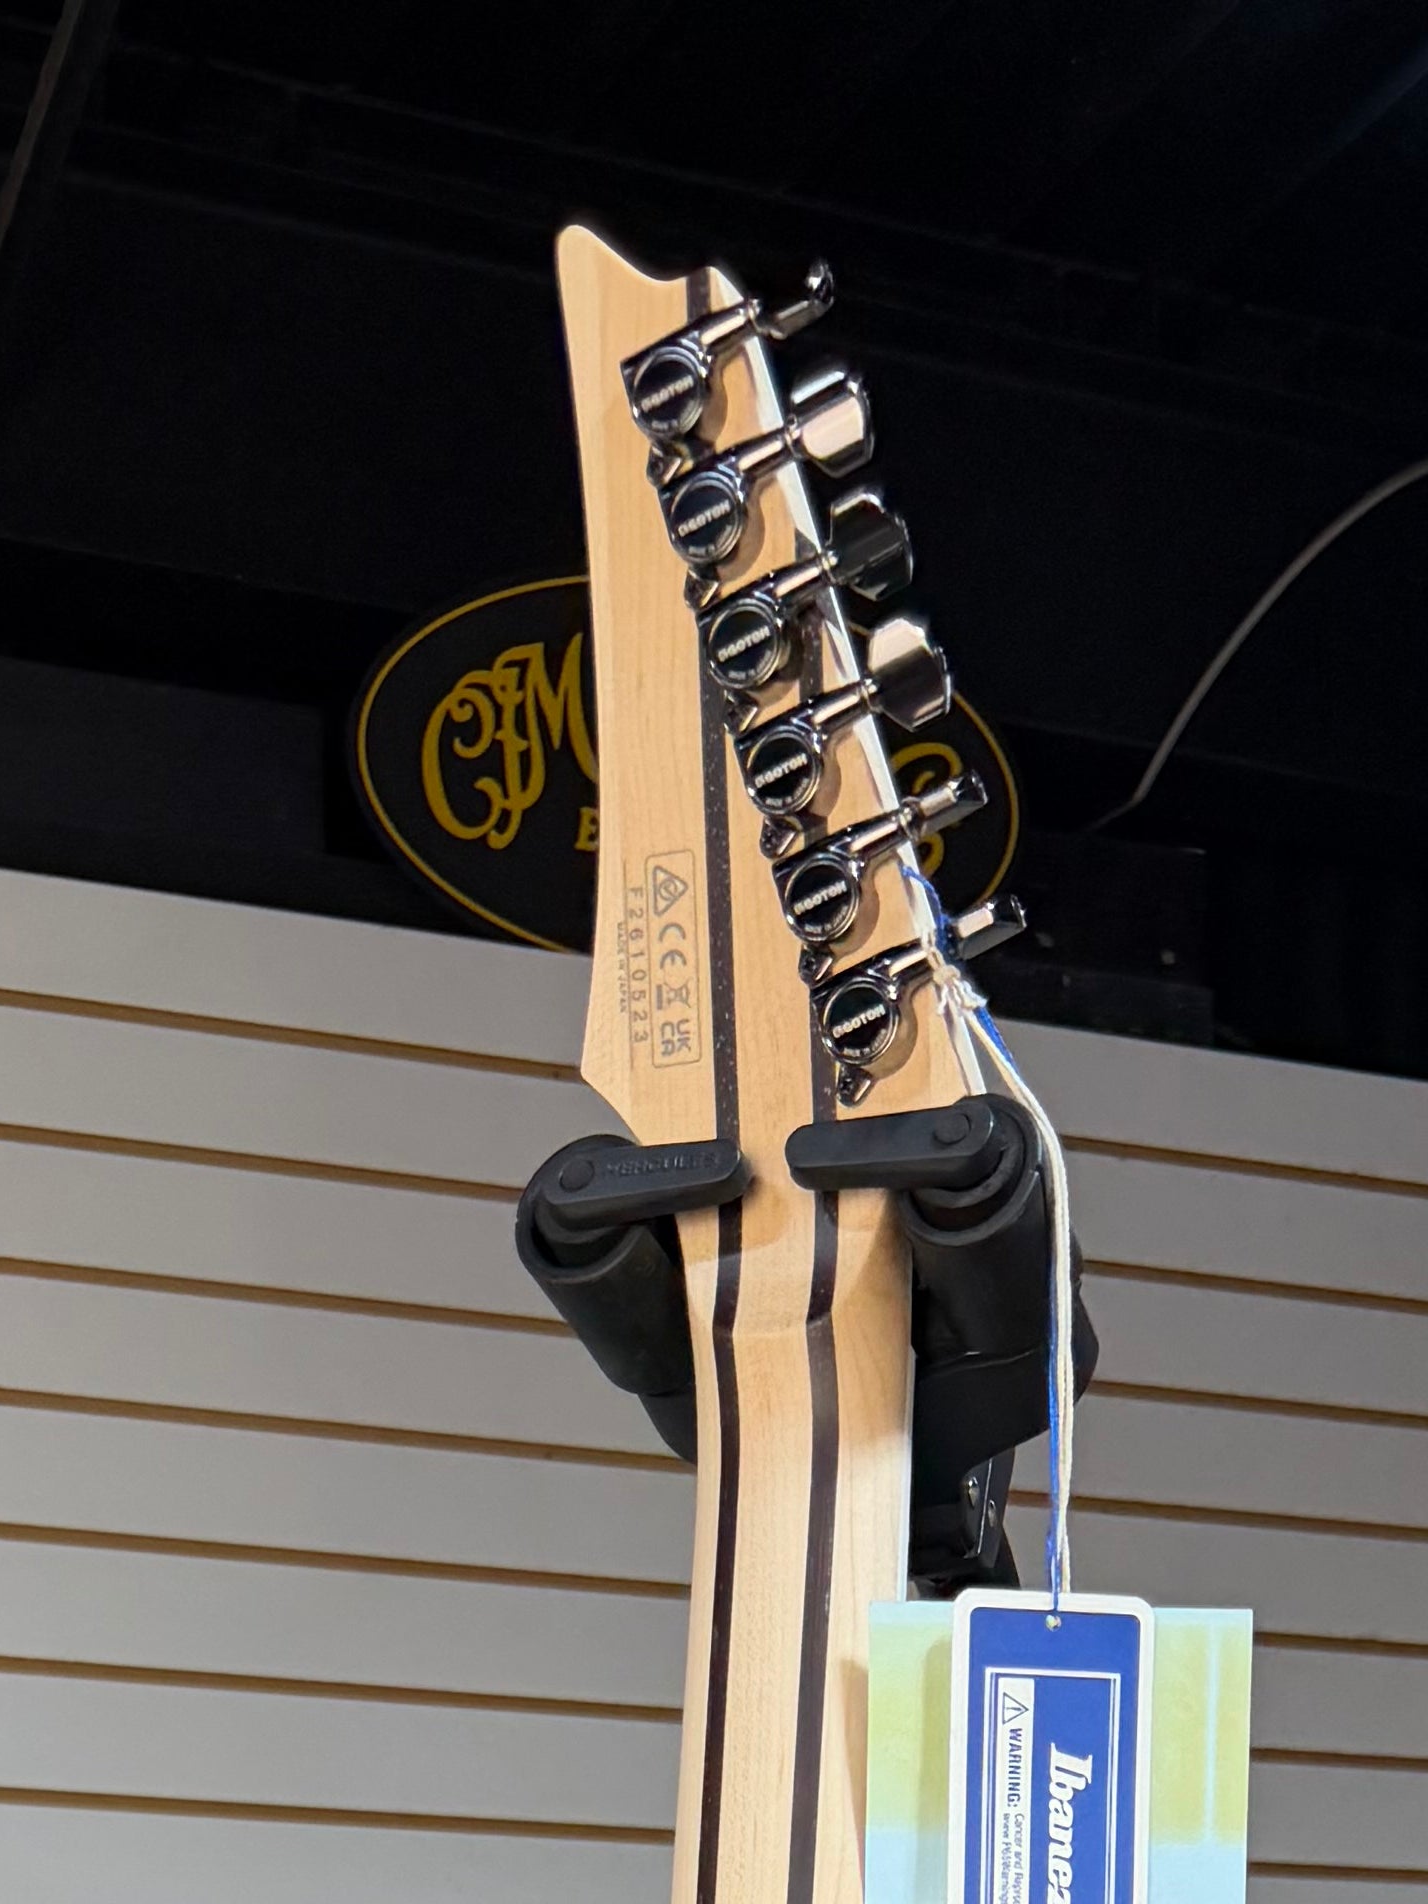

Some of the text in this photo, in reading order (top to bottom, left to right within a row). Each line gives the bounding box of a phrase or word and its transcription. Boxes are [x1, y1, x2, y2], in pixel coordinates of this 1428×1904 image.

[628, 887, 649, 1044] F2610523
[1007, 1728, 1023, 1808] WARNING:
[1014, 1813, 1025, 1848] Cancer
